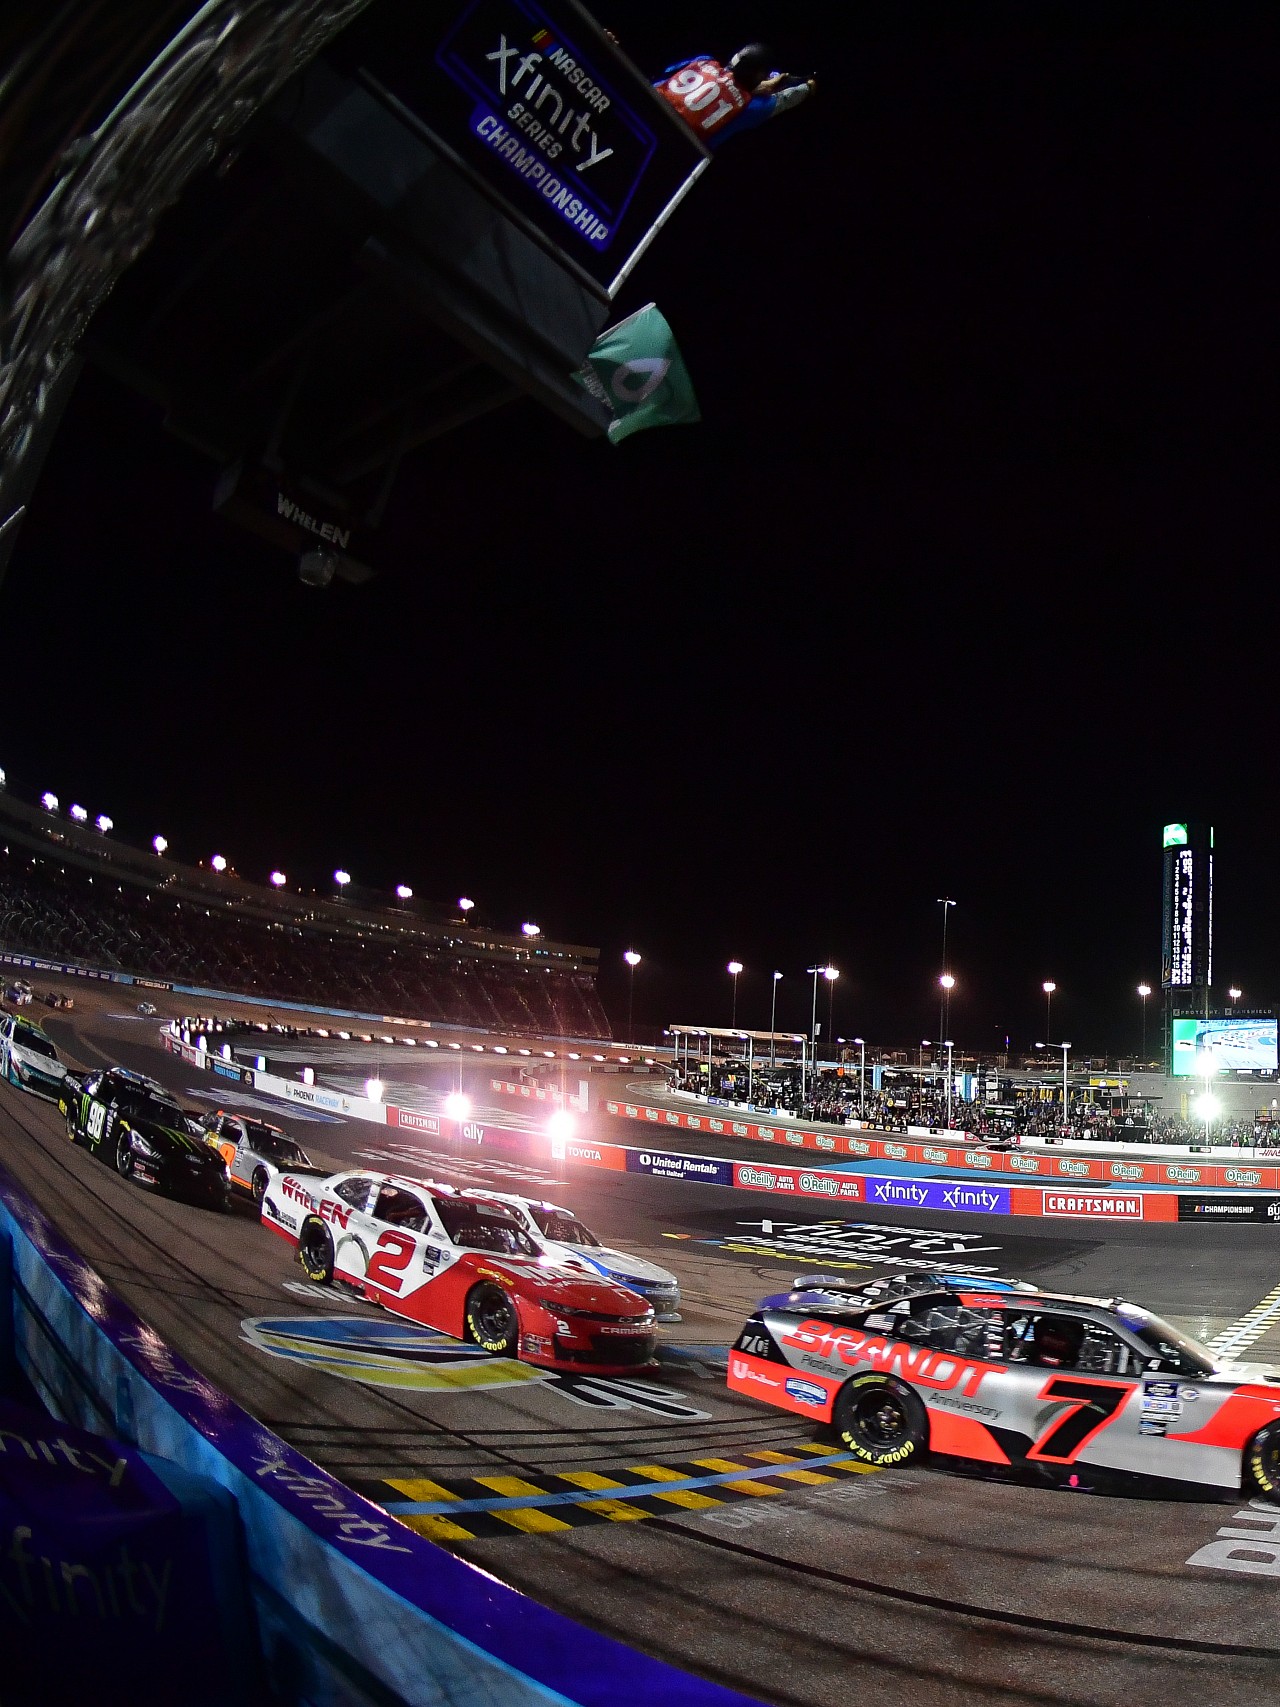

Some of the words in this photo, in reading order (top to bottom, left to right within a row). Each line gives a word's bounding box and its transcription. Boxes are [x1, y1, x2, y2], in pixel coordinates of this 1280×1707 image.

[549, 47, 611, 112] NASCAR
[485, 33, 614, 172] xfinity
[668, 69, 733, 129] 901
[507, 102, 563, 159] SERIES
[476, 116, 609, 241] CHAMPIONSHIP
[276, 491, 350, 549] WHELEN
[293, 1088, 314, 1102] PHOENIX
[315, 1092, 340, 1108] RACEWAY
[87, 1100, 106, 1140] 98
[400, 1112, 438, 1131] CRAFTSMAN
[464, 1125, 484, 1144] ally
[568, 1146, 602, 1161] TOYOTA
[884, 1144, 907, 1159] O'Reilly
[923, 1149, 949, 1163] O'Reilly
[965, 1152, 992, 1168] O'Reilly
[652, 1156, 682, 1170] United
[683, 1160, 719, 1174] Rentals
[1010, 1155, 1039, 1171] O'Reilly
[1059, 1159, 1090, 1176] O'Reilly
[1112, 1163, 1144, 1180] O'Reilly
[739, 1167, 776, 1189] O'Reilly
[778, 1175, 793, 1183] AUTO
[799, 1174, 840, 1196] O'Reilly
[1167, 1166, 1201, 1184] O'Reilly
[1225, 1168, 1262, 1186] O'Reilly
[777, 1182, 794, 1190] PARTS
[840, 1189, 859, 1197] PARTS
[875, 1181, 928, 1205] xfinity
[943, 1187, 1000, 1210] xfinity
[282, 1176, 354, 1230] WHELEN
[1048, 1196, 1136, 1213] CRAFTSMAN
[1204, 1205, 1254, 1213] CHAMPIONSHIP
[735, 1219, 1004, 1255] xfinity
[365, 1230, 416, 1292] 2
[724, 1235, 999, 1273] CHAMPIONSHIP
[556, 1320, 571, 1335] 2
[601, 1326, 654, 1335] CAMARO
[781, 1319, 1009, 1398] BRANDT
[801, 1354, 848, 1377] Platinum
[929, 1392, 1003, 1421] Anniversary
[1027, 1374, 1139, 1465] 7
[251, 1456, 414, 1554] xfinity
